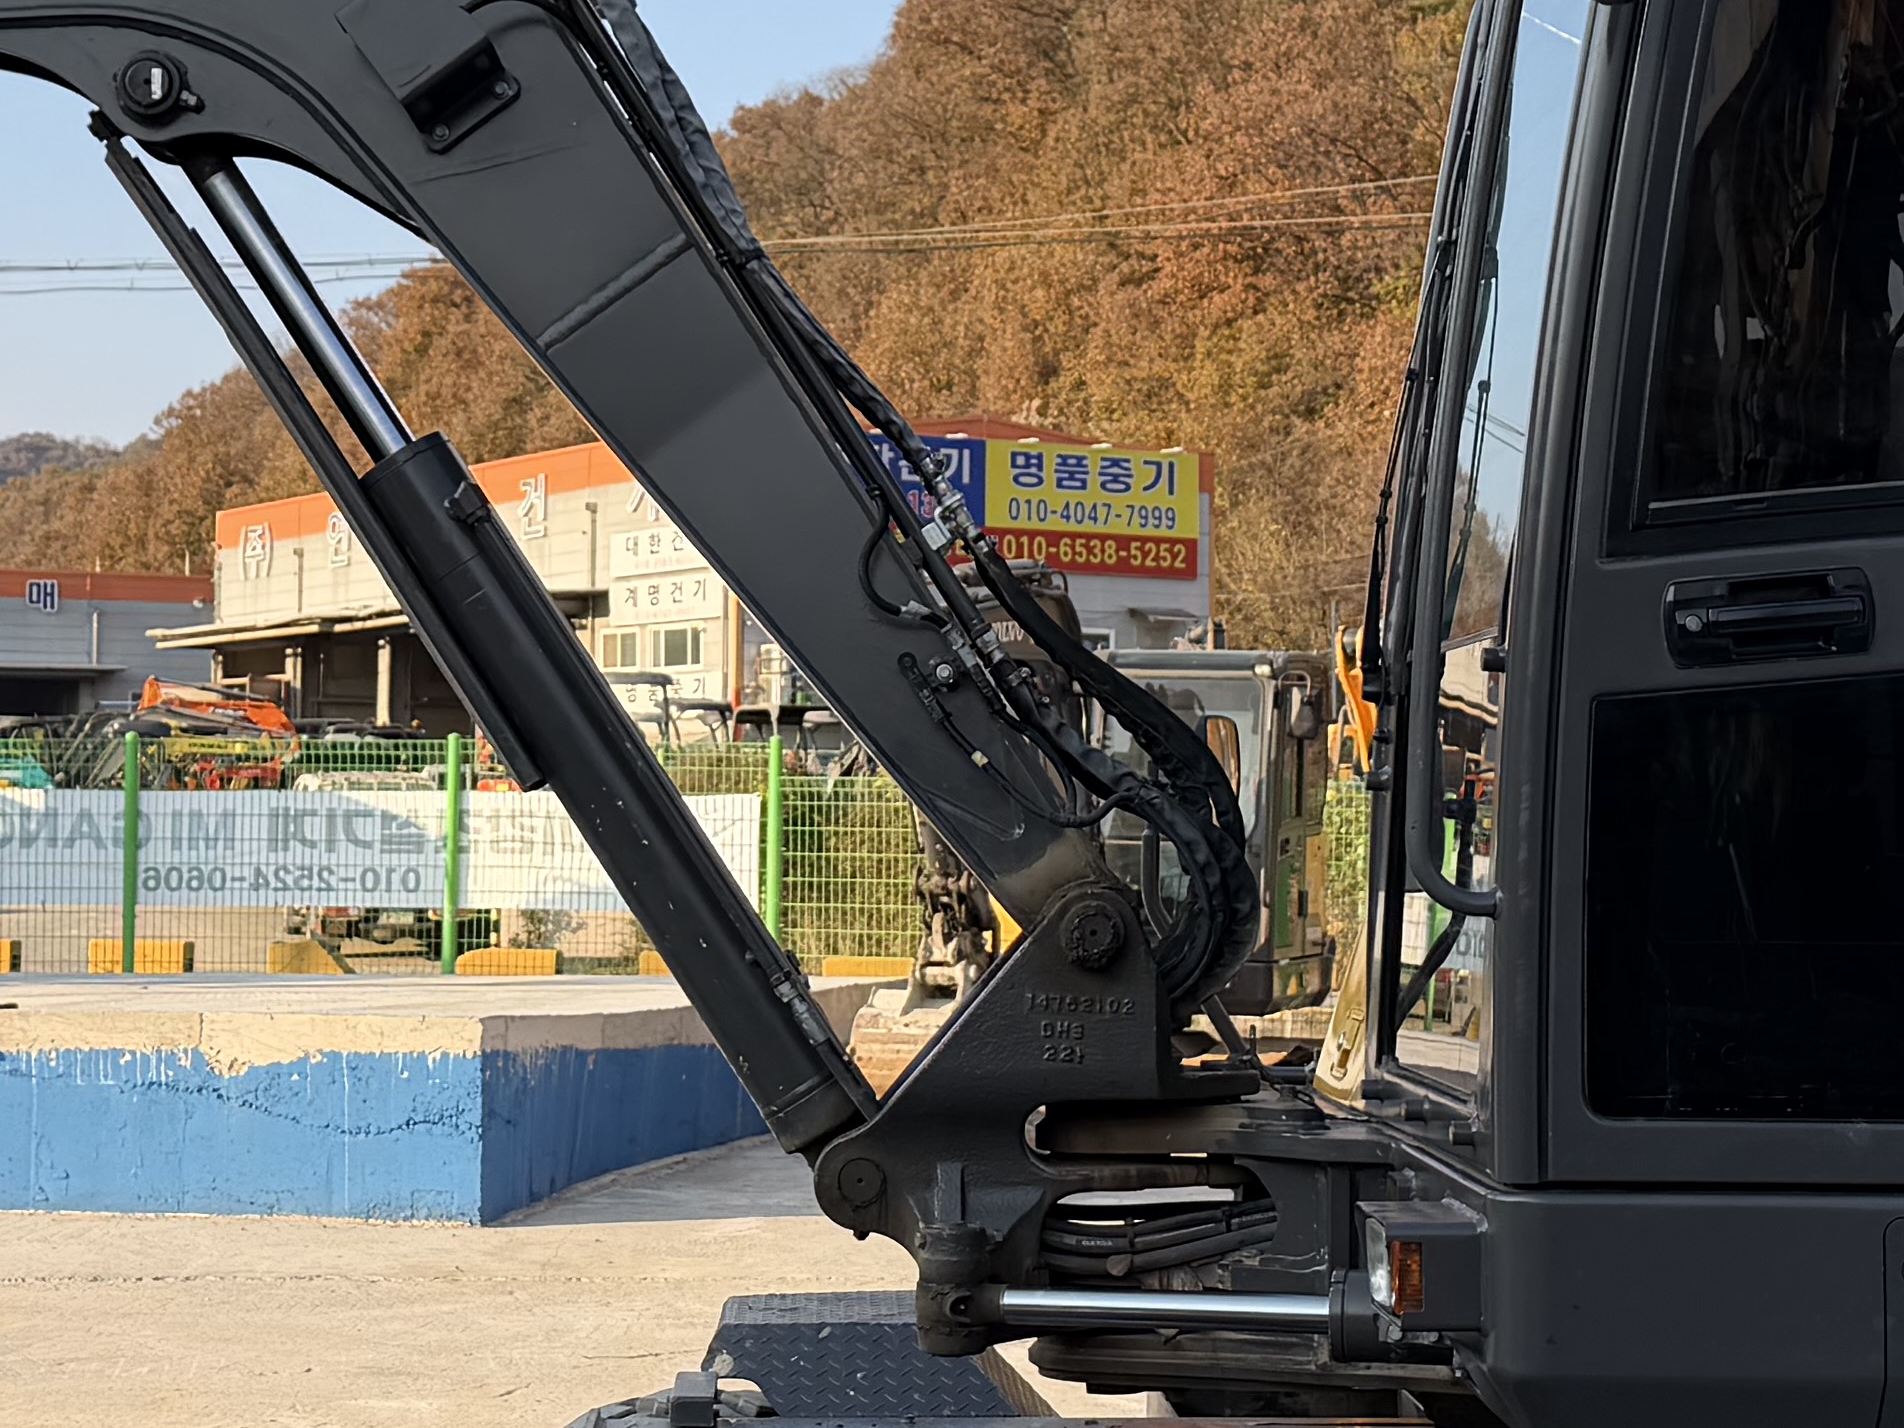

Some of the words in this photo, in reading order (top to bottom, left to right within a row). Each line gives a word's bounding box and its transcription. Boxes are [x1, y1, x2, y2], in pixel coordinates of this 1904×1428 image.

[1009, 449, 1177, 498] 명품중기
[1007, 495, 1177, 531] 010-4047-7999
[1002, 534, 1187, 570] 010-6538-5252
